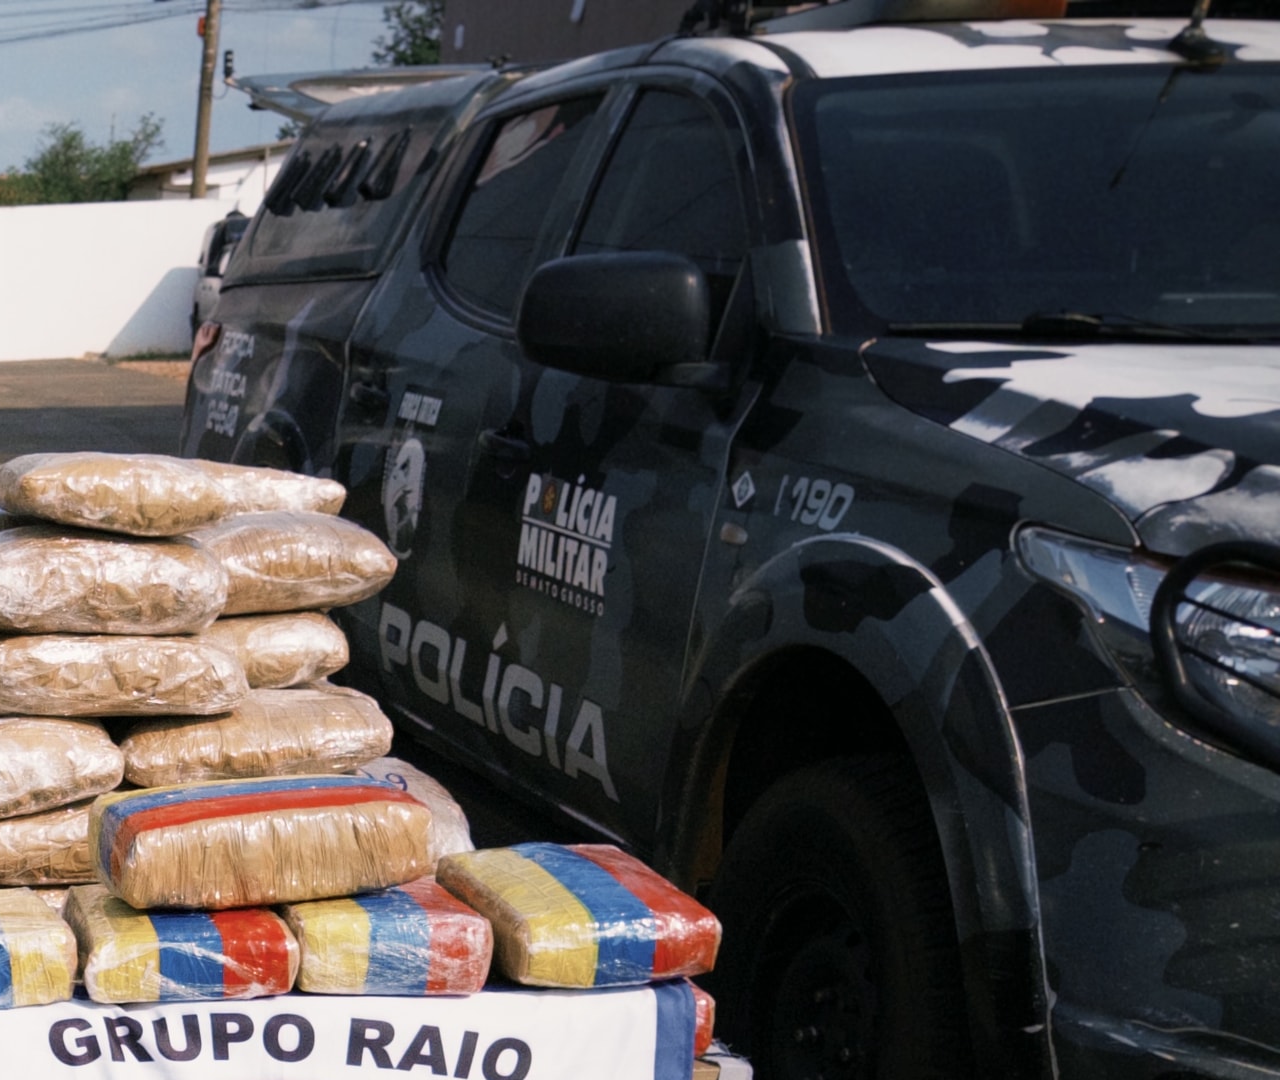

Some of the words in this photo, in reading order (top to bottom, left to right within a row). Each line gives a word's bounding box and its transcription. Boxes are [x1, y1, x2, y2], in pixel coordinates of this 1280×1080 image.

[517, 523, 608, 596] MILITAR
[561, 589, 604, 616] GROSSO
[378, 603, 620, 803] POLÍCIA
[48, 1011, 316, 1067] GRUPO
